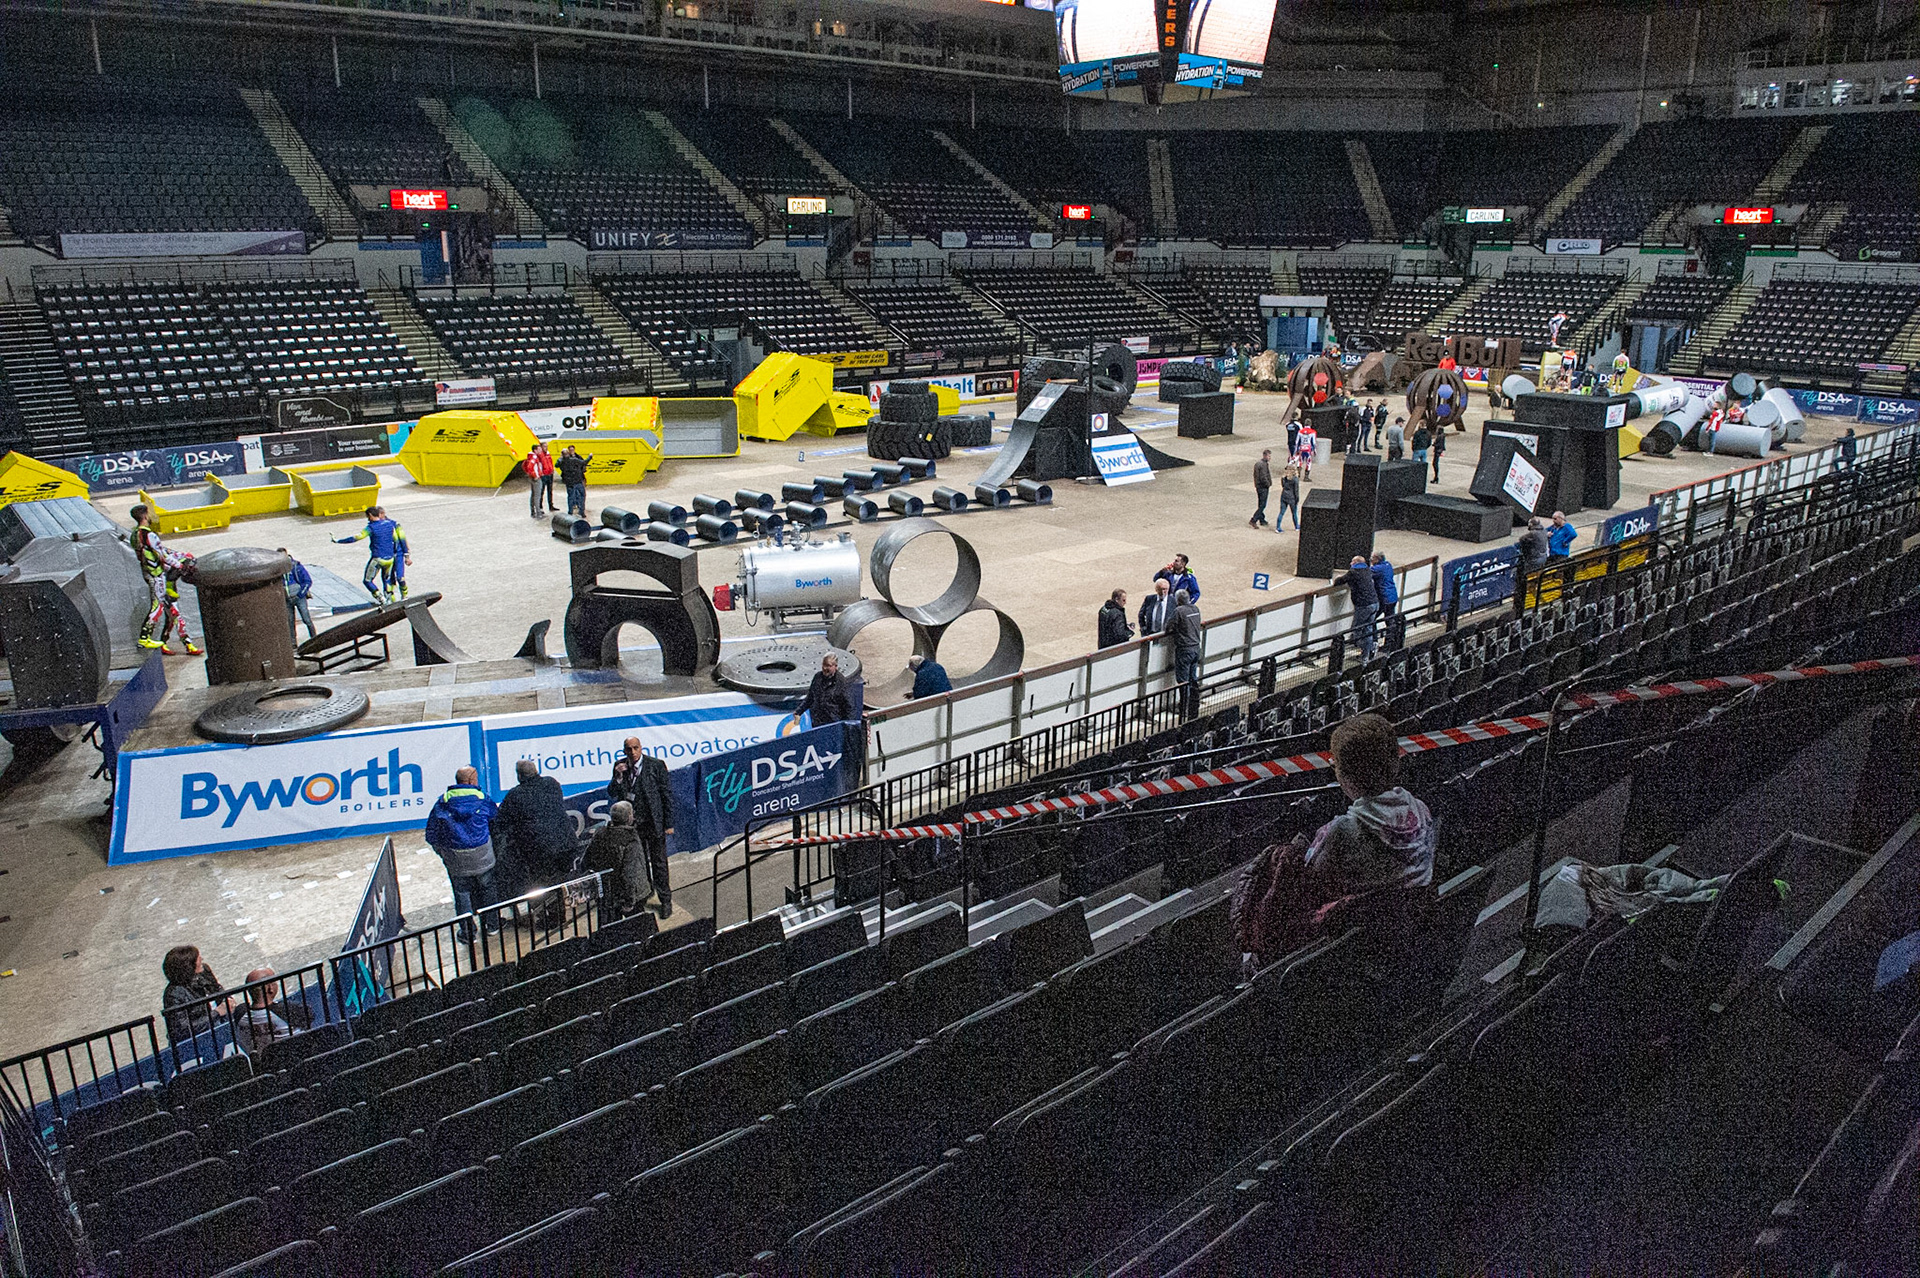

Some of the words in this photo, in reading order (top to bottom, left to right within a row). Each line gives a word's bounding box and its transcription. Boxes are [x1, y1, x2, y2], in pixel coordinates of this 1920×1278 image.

[1061, 68, 1100, 93] HYDRATION
[1175, 65, 1215, 82] HYDRATION
[1226, 66, 1263, 78] POWERADE
[791, 201, 822, 212] CARLING
[1470, 211, 1500, 221] CARLING
[595, 232, 651, 246] UNIFY
[1459, 335, 1522, 368] Bull
[1096, 449, 1147, 472] Byworth
[107, 476, 133, 485] arena
[795, 577, 833, 589] Byworth
[1255, 575, 1267, 588] 2
[180, 747, 424, 828] Byworth
[751, 784, 781, 797] Doncaster
[781, 778, 805, 790] Sheffield
[804, 772, 825, 784] Airport
[340, 797, 425, 814] BOILERS
[752, 793, 800, 817] arena
